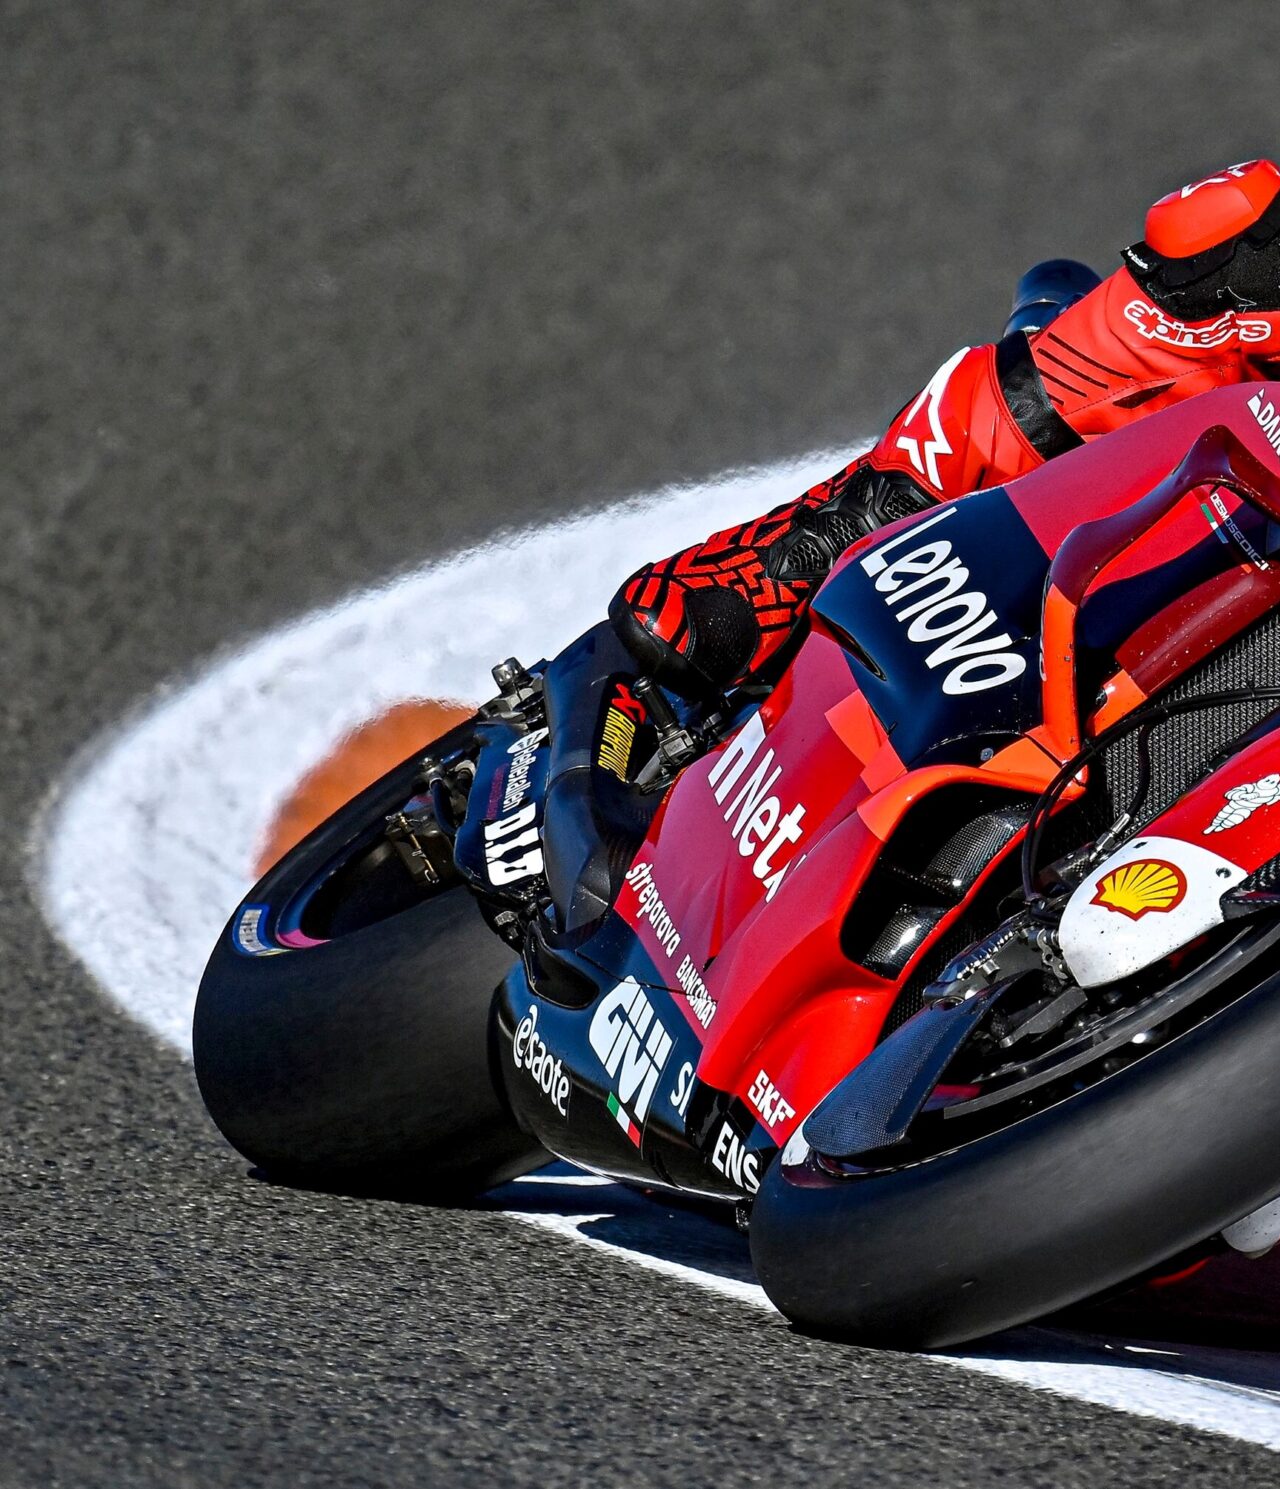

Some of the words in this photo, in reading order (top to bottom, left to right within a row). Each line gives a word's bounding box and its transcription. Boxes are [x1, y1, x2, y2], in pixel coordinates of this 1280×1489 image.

[1210, 492, 1269, 571] DESMOSEDICI
[859, 506, 1027, 695] Lenovo
[625, 861, 682, 958] streparava
[670, 1061, 697, 1123] SI
[747, 1068, 797, 1128] SKF
